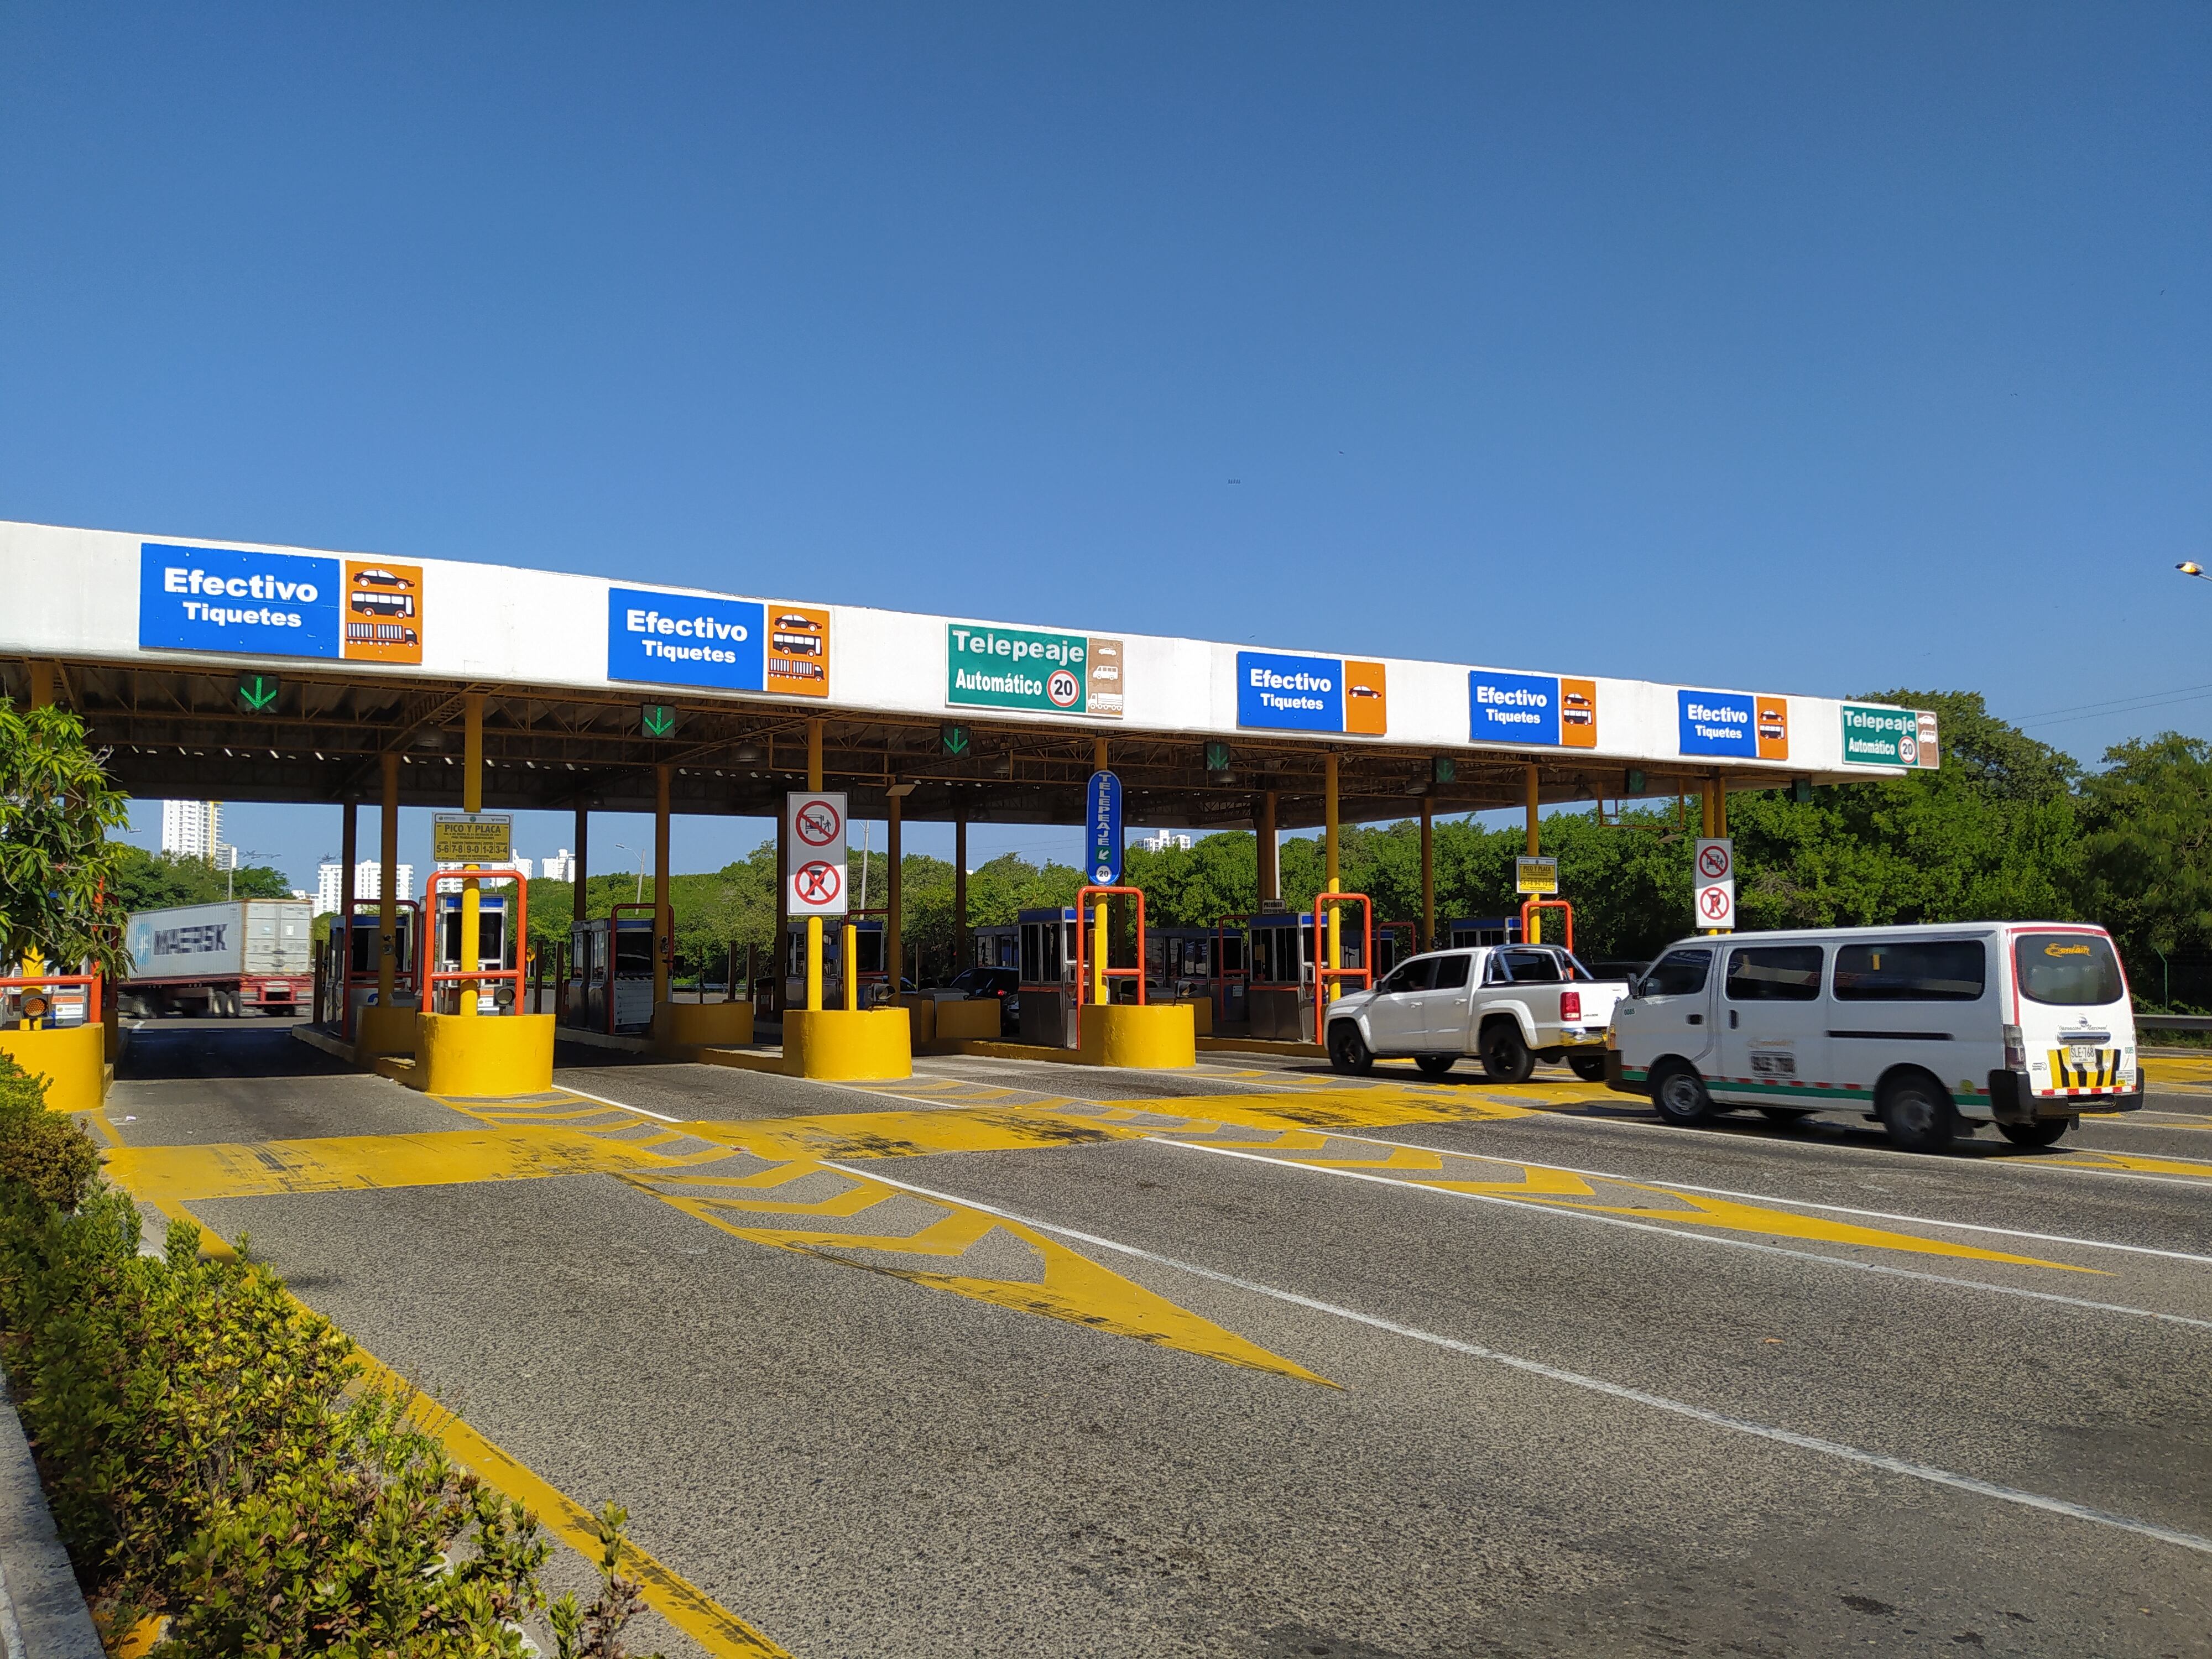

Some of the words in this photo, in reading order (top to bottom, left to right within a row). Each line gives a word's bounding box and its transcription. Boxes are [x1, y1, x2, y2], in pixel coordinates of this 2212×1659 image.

[164, 568, 319, 602] Efectivo
[182, 601, 302, 628] Tiquetes
[627, 609, 748, 641] Efectivo
[642, 639, 736, 664] Tiquetes
[952, 629, 1084, 666] Telepeaje
[955, 669, 1042, 696] Automático
[1054, 680, 1073, 696] 20
[1250, 669, 1332, 692] Efectivo
[1260, 693, 1324, 710] Tiquetes
[1477, 686, 1547, 707] Efectivo
[1485, 708, 1541, 724] Tiquetes
[1688, 704, 1748, 723] Efectivo
[1844, 711, 1916, 735] Telepeaje
[1695, 725, 1743, 740] Tiquetes
[1848, 737, 1895, 755] Automático
[1902, 743, 1913, 755] 20
[1096, 774, 1112, 846] TELEPEAJE
[475, 825, 501, 833] PLACA
[436, 844, 449, 853] 5-6
[452, 845, 463, 853] 7-8
[467, 845, 479, 853] 9-0
[483, 846, 493, 854] 1-2
